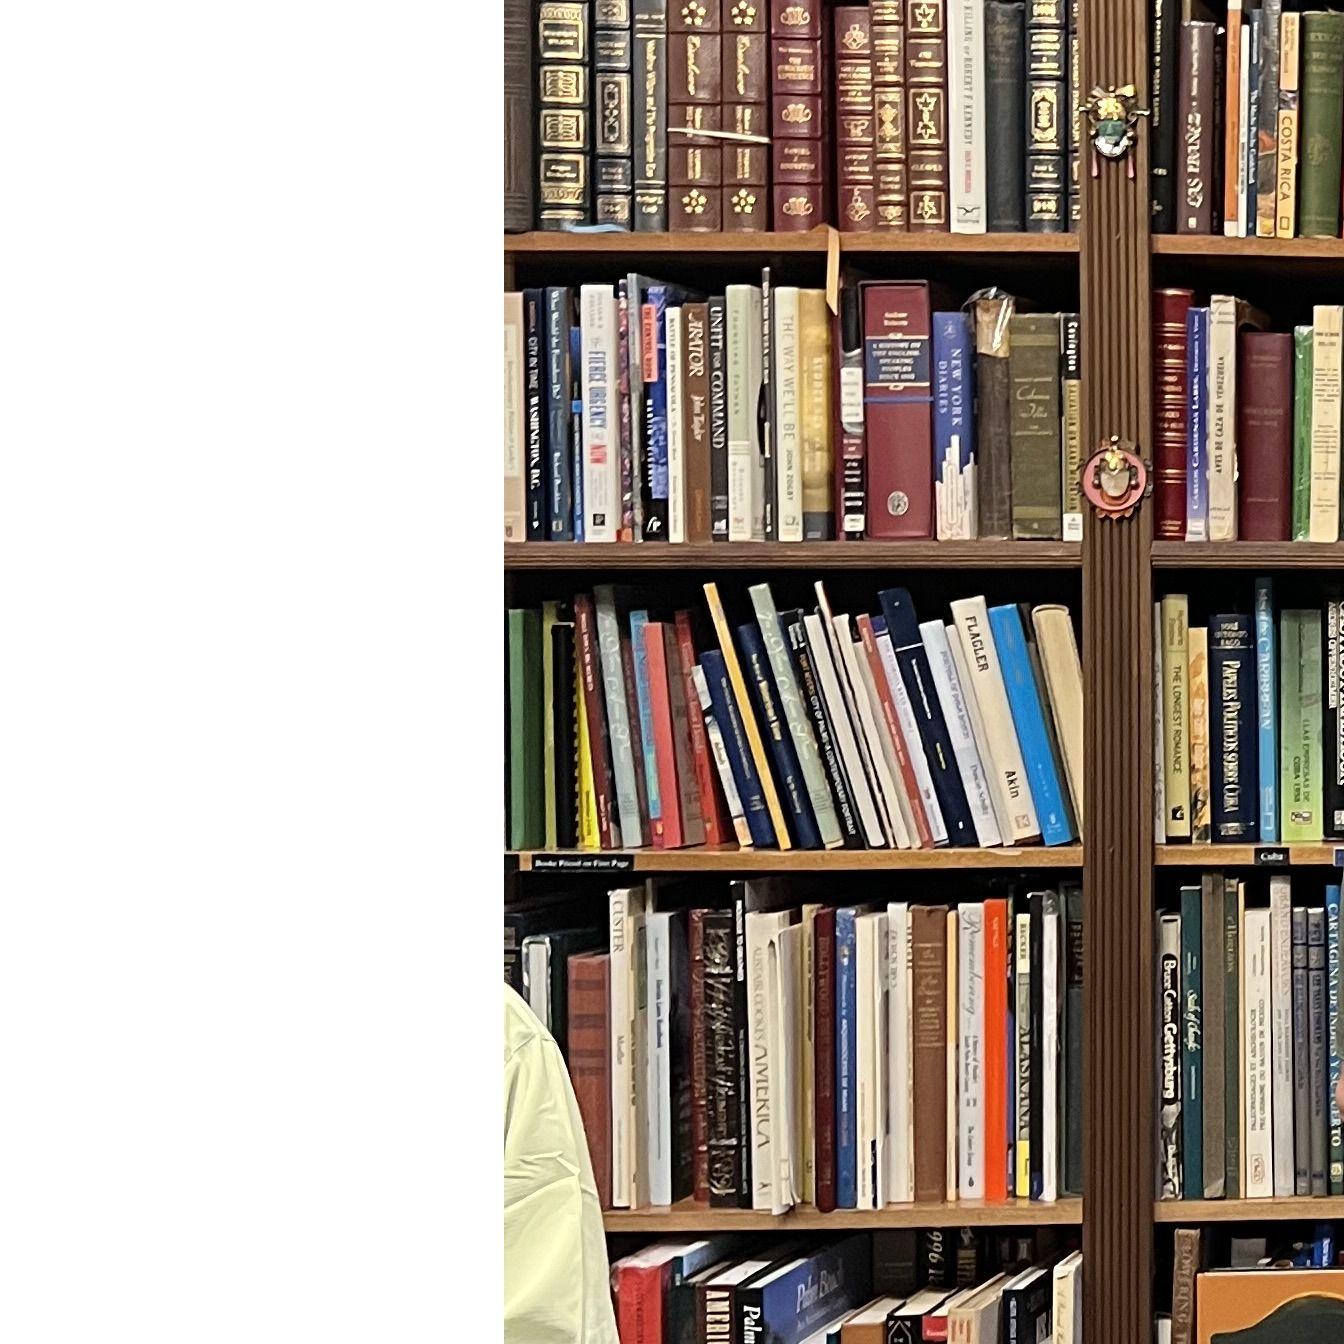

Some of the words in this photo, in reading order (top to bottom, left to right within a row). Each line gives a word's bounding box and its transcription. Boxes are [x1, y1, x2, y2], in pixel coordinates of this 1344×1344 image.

[1280, 116, 1291, 163] COSTA
[1279, 167, 1291, 202] RICA
[589, 350, 607, 384] FIERCE
[951, 348, 962, 381] NEW
[1067, 321, 1078, 371] Covington
[588, 386, 607, 429] URGENCY
[938, 360, 948, 414] DIARIES
[952, 384, 963, 427] YORK
[589, 444, 607, 465] NOW
[965, 614, 989, 673] FLAGLER
[1172, 665, 1182, 683] THE
[1172, 684, 1182, 728] LONGEST
[1172, 729, 1182, 774] ROMANCE
[1004, 769, 1020, 799] Akin
[1260, 851, 1284, 861] Cuba
[612, 899, 625, 953] CUSTER
[961, 910, 982, 1016] Remembering
[1163, 959, 1177, 988] Bruce
[1163, 988, 1176, 1022] Catton
[1162, 1022, 1177, 1099] Gettysburg
[741, 1305, 760, 1344] Palm
